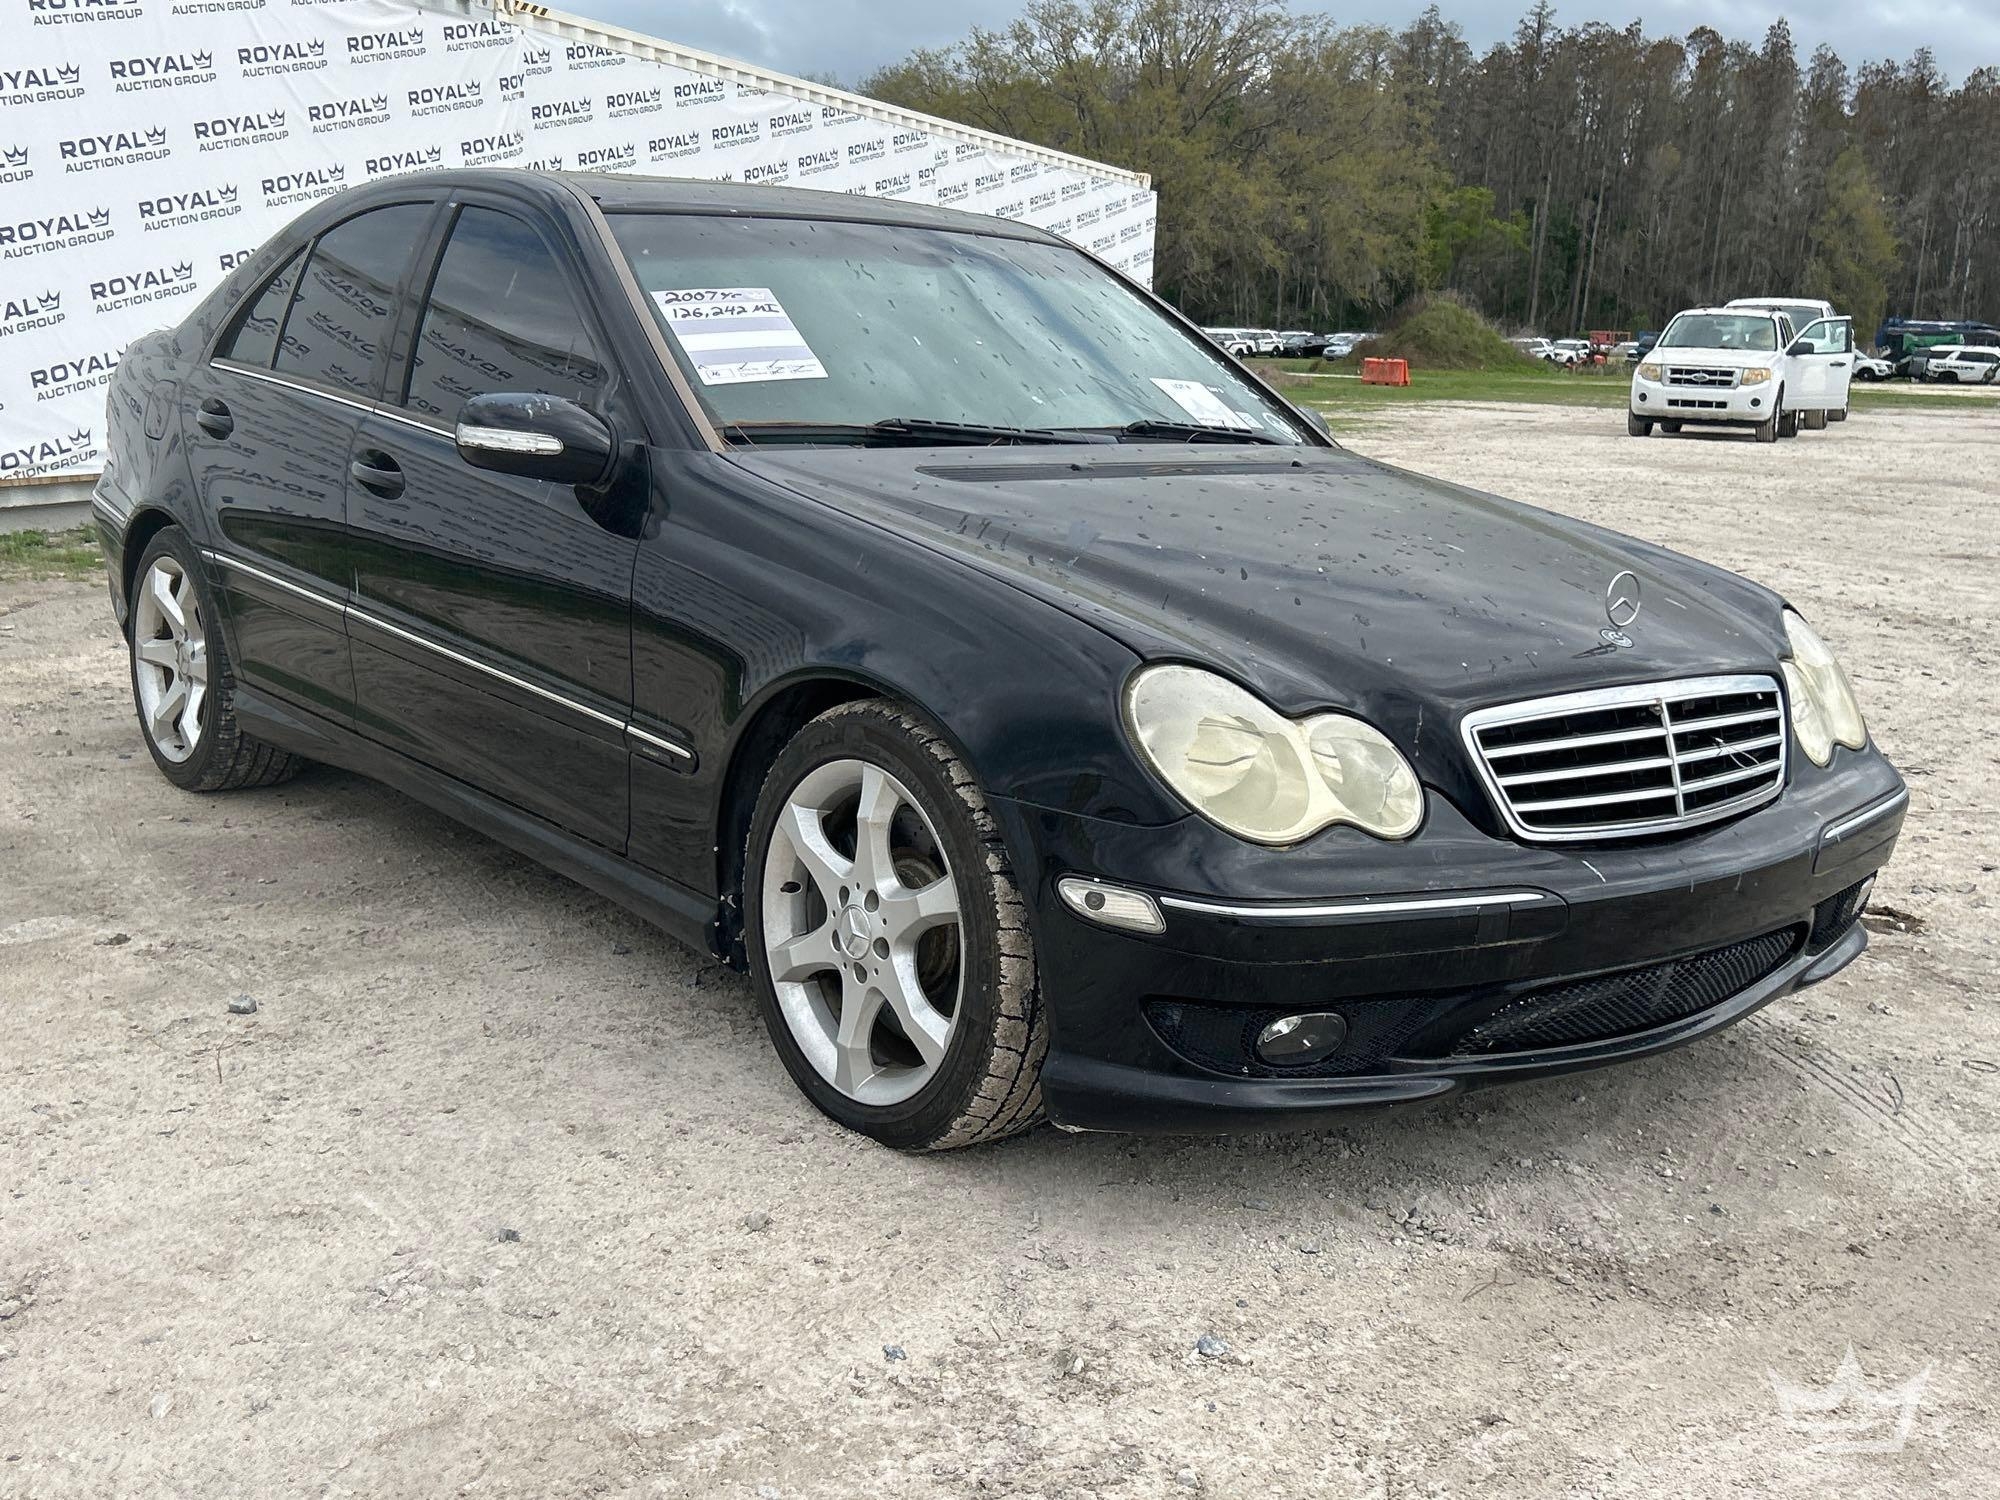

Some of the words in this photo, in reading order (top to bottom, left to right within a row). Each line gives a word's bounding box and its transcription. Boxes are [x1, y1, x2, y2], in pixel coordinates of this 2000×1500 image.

[33, 12, 95, 26] AUCTION
[97, 8, 144, 21] GROUP
[171, 2, 226, 16] AUCTION
[443, 21, 500, 41] ROYAL
[346, 31, 409, 52] ROYAL
[446, 40, 485, 52] AUCTION
[487, 36, 514, 48] GROUP
[237, 43, 309, 65] ROYAL
[350, 51, 392, 65] AUCTION
[393, 47, 427, 59] GROUP
[109, 54, 194, 79] ROYAL
[242, 65, 290, 78] AUCTION
[292, 59, 328, 72] GROUP
[525, 65, 552, 77] GROUP
[568, 60, 600, 71] AUCTION
[601, 57, 626, 69] GROUP
[0, 68, 58, 90] YAL
[115, 78, 172, 93] AUCTION
[174, 72, 217, 86] GROUP
[36, 87, 85, 102] GROUP
[408, 84, 467, 106] ROYAL
[607, 90, 650, 109] ROYAL
[674, 81, 714, 99] ROYAL
[308, 98, 373, 121] ROYAL
[411, 104, 451, 117] AUCTION
[452, 98, 484, 111] GROUP
[531, 100, 580, 120] ROYAL
[676, 98, 703, 108] AUCTION
[704, 93, 726, 105] GROUP
[608, 107, 639, 119] AUCTION
[640, 103, 663, 114] GROUP
[194, 114, 269, 139] ROYAL
[312, 118, 356, 134] AUCTION
[357, 113, 391, 127] GROUP
[534, 118, 567, 130] AUCTION
[568, 114, 593, 126] GROUP
[769, 113, 804, 129] ROYAL
[199, 136, 250, 152] AUCTION
[251, 130, 289, 144] GROUP
[712, 123, 749, 141] ROYAL
[893, 131, 921, 146] ROYAL
[59, 131, 147, 159] ROYAL
[461, 133, 515, 156] ROYAL
[649, 134, 690, 153] ROYAL
[713, 139, 740, 150] AUCTION
[740, 135, 760, 145] GROUP
[848, 140, 877, 157] ROYAL
[65, 155, 125, 173] AUCTION
[126, 148, 171, 164] GROUP
[365, 150, 427, 174] ROYAL
[464, 154, 502, 167] AUCTION
[578, 146, 624, 166] ROYAL
[651, 151, 679, 162] AUCTION
[680, 146, 701, 157] GROUP
[798, 151, 831, 168] ROYAL
[612, 159, 637, 171] GROUP
[744, 163, 780, 182] ROYAL
[261, 169, 329, 195] ROYAL
[875, 176, 903, 191] ROYAL
[937, 183, 962, 198] ROYAL
[138, 190, 220, 218] ROYAL
[265, 190, 312, 208] AUCTION
[313, 184, 348, 198] GROUP
[144, 212, 199, 232] AUCTION
[200, 205, 242, 221] GROUP
[0, 214, 89, 245] ROYAL
[3, 238, 66, 260] AUCTION
[68, 229, 115, 247] GROUP
[90, 268, 173, 300] ROYAL
[96, 293, 152, 314] AUCTION
[154, 282, 197, 300] GROUP
[665, 291, 717, 304] 2007
[673, 306, 748, 319] 126,242
[17, 313, 66, 332] GROUP
[31, 355, 118, 388] ROYAL
[37, 376, 96, 401] AUCTION
[50, 450, 97, 470] GROUP
